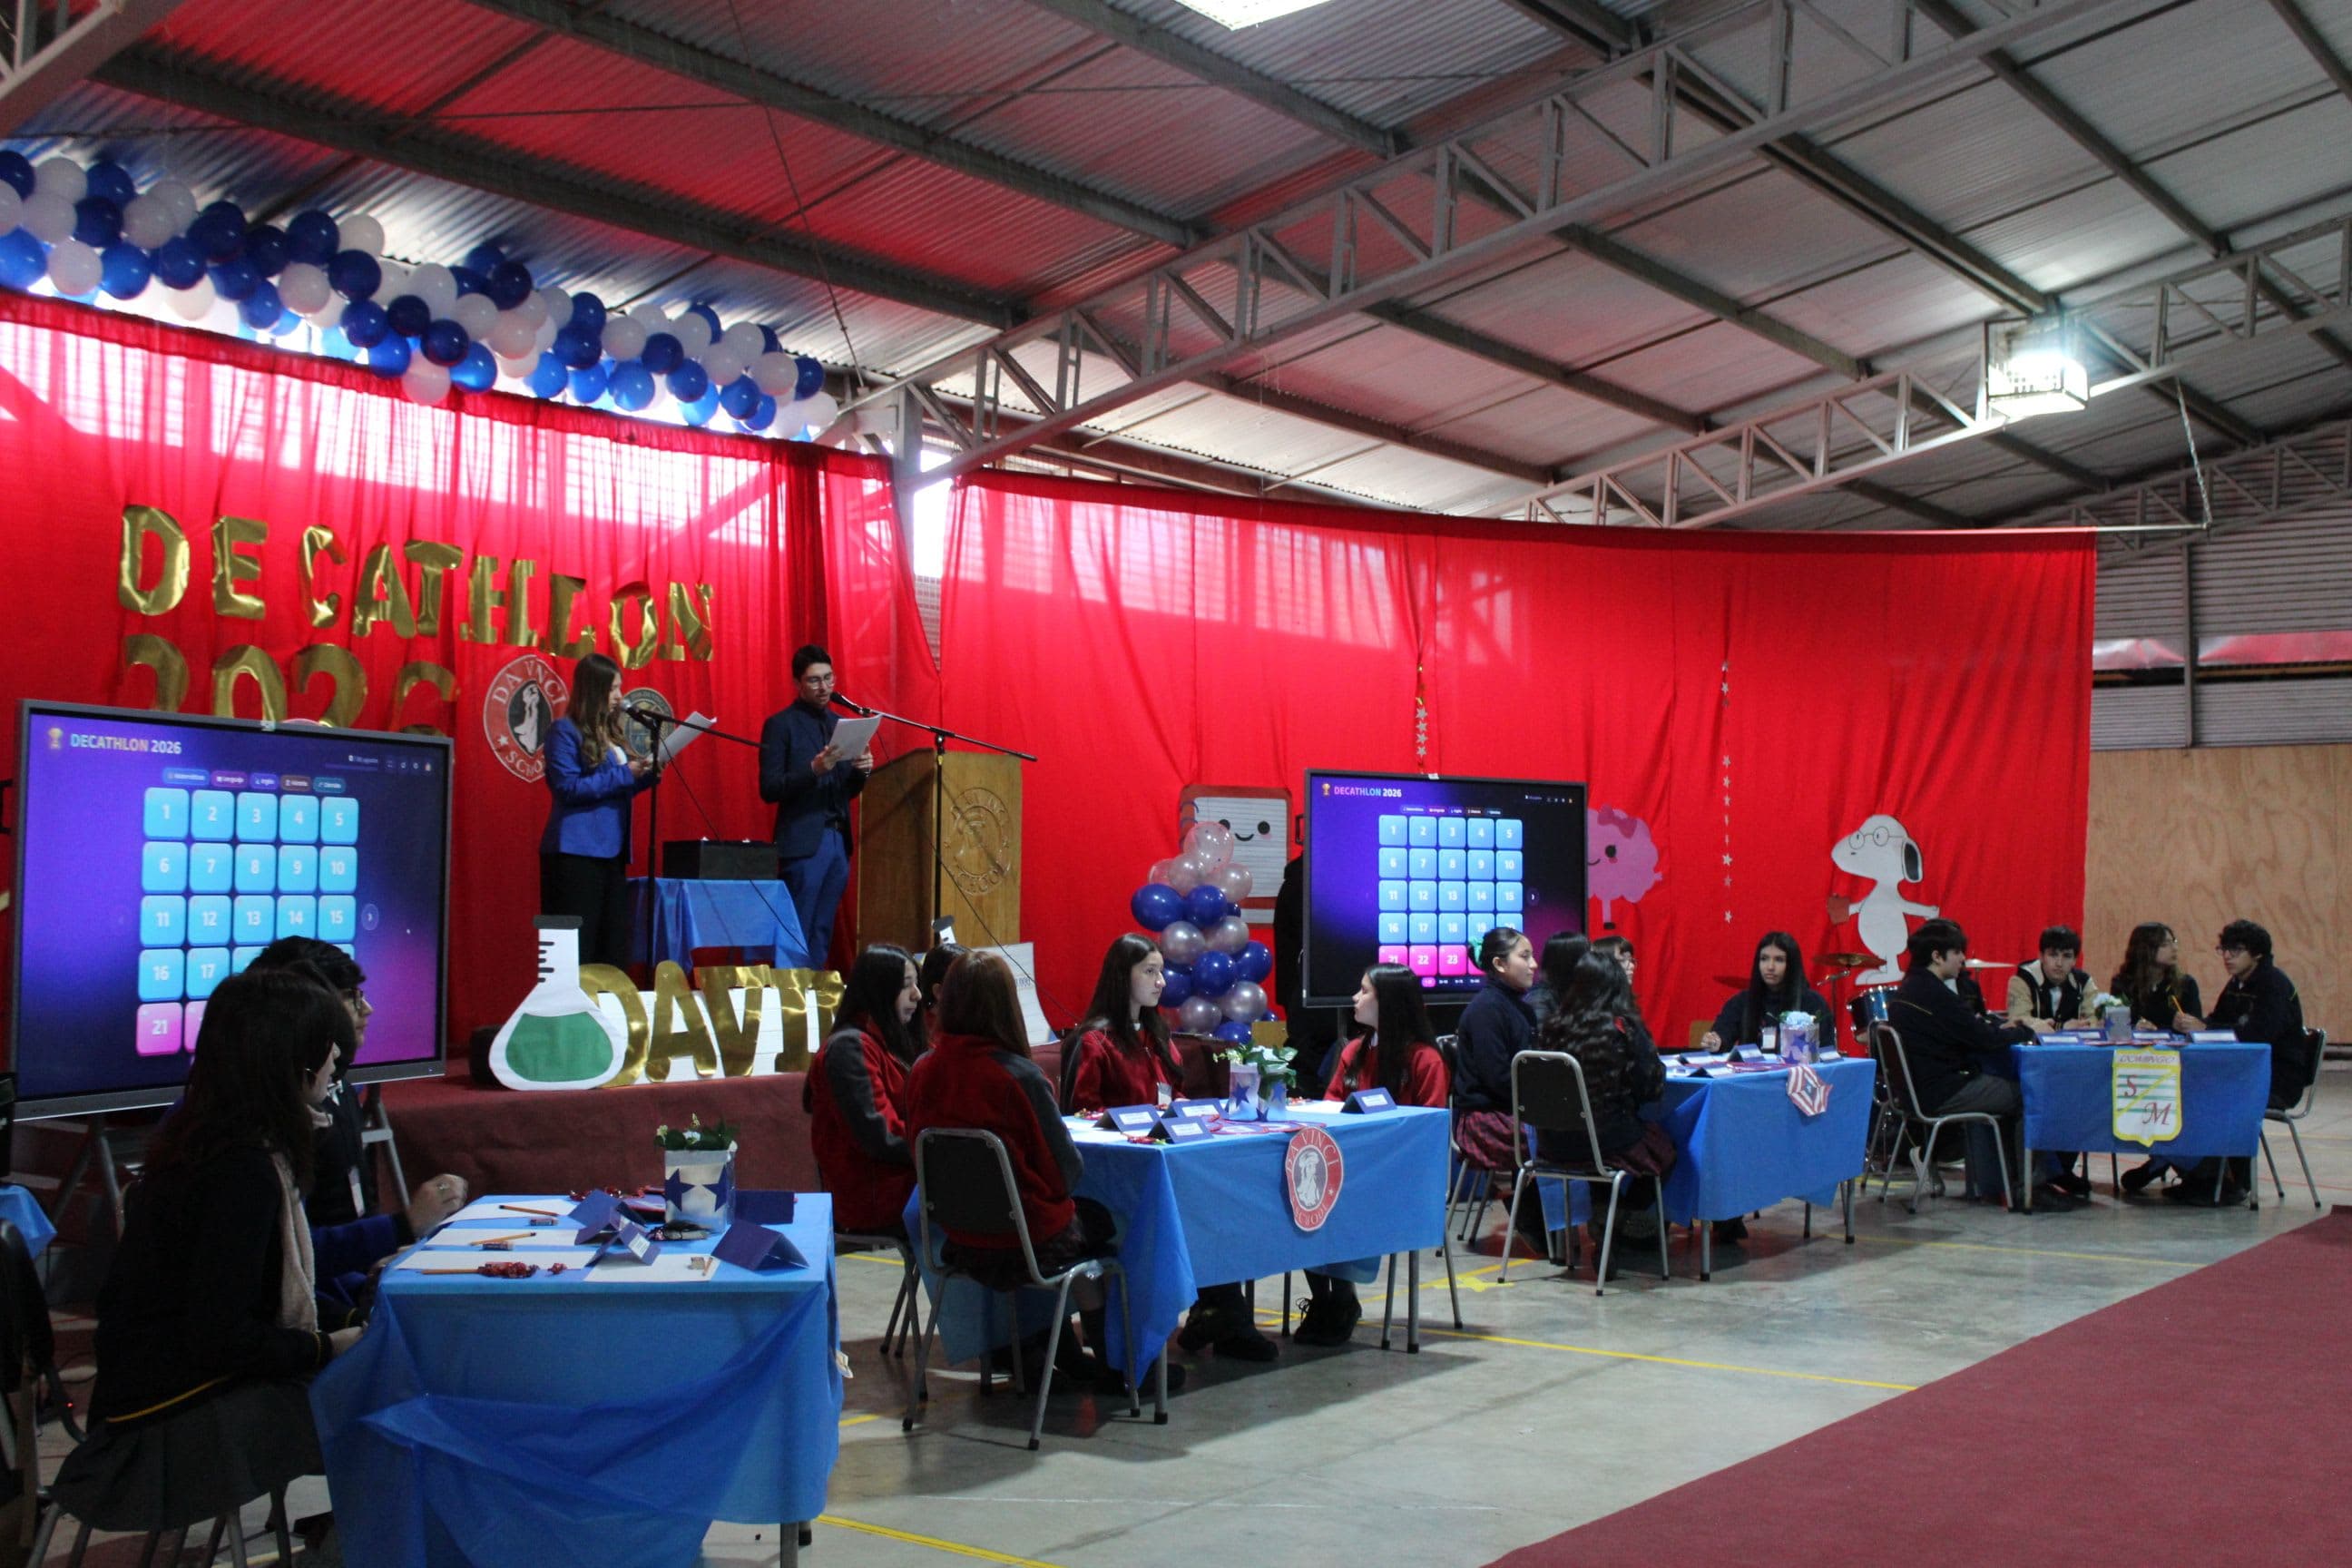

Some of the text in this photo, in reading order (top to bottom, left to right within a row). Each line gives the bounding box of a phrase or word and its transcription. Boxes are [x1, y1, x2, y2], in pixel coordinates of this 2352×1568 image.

[119, 505, 715, 670] DECATHLON
[124, 633, 458, 737] 2026
[493, 672, 523, 705] DA
[70, 732, 181, 755] DECATHLON 2026
[1334, 785, 1402, 799] DECATHLON 2026
[162, 804, 343, 827] 1 2 3 4 5
[1420, 826, 1426, 836] 2
[1449, 828, 1455, 838] 3
[1478, 828, 1485, 838] 4
[1506, 828, 1513, 838] 5
[160, 858, 345, 876] 6 7 8 9 10
[1420, 858, 1426, 868] 7
[1449, 858, 1456, 868] 8
[1478, 859, 1485, 869] 9
[1504, 860, 1514, 870] 10
[1387, 891, 1514, 901] 11 12 13 14 15
[155, 910, 344, 927] 11 12 13 14 15
[1387, 923, 1399, 933] 16
[1418, 923, 1429, 933] 17
[1447, 923, 1458, 933] 18
[1476, 922, 1486, 933] 19
[1388, 955, 1458, 965] 21 22 23
[152, 964, 215, 981] 16 17
[152, 1019, 168, 1035] 21
[2124, 1074, 2138, 1097] S
[2142, 1102, 2172, 1125] M
[1300, 1130, 1339, 1166] VINCI
